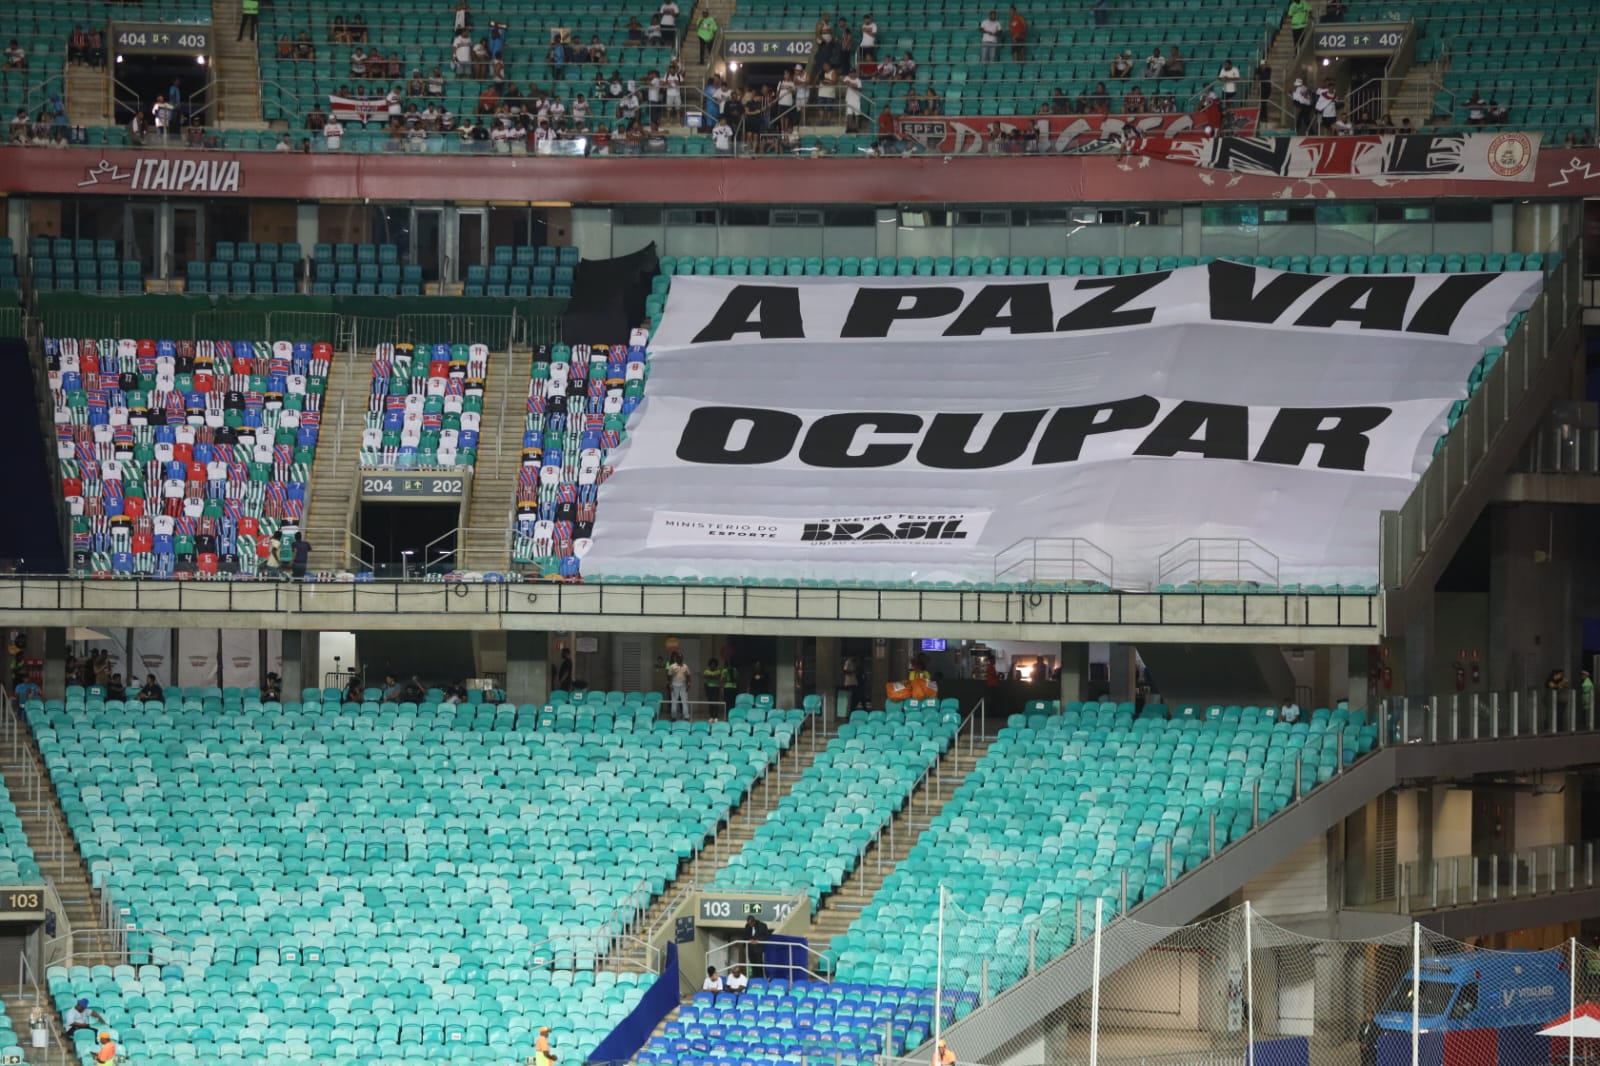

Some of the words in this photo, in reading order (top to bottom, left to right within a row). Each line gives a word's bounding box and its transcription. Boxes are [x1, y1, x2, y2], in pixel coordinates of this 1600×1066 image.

[119, 33, 146, 46] 404
[178, 34, 206, 48] 403
[728, 42, 756, 54] 403
[786, 42, 813, 54] 402
[1318, 34, 1346, 48] 402
[130, 158, 240, 192] ITAIPAVA
[691, 284, 806, 344] A
[840, 268, 1174, 338] PAZ
[1207, 259, 1504, 336] VAI
[676, 394, 1393, 472] OCUPAR
[364, 480, 393, 492] 204
[432, 480, 462, 492] 202
[800, 520, 968, 542] BRASIL
[9, 894, 38, 908] 103
[704, 902, 731, 917] 103
